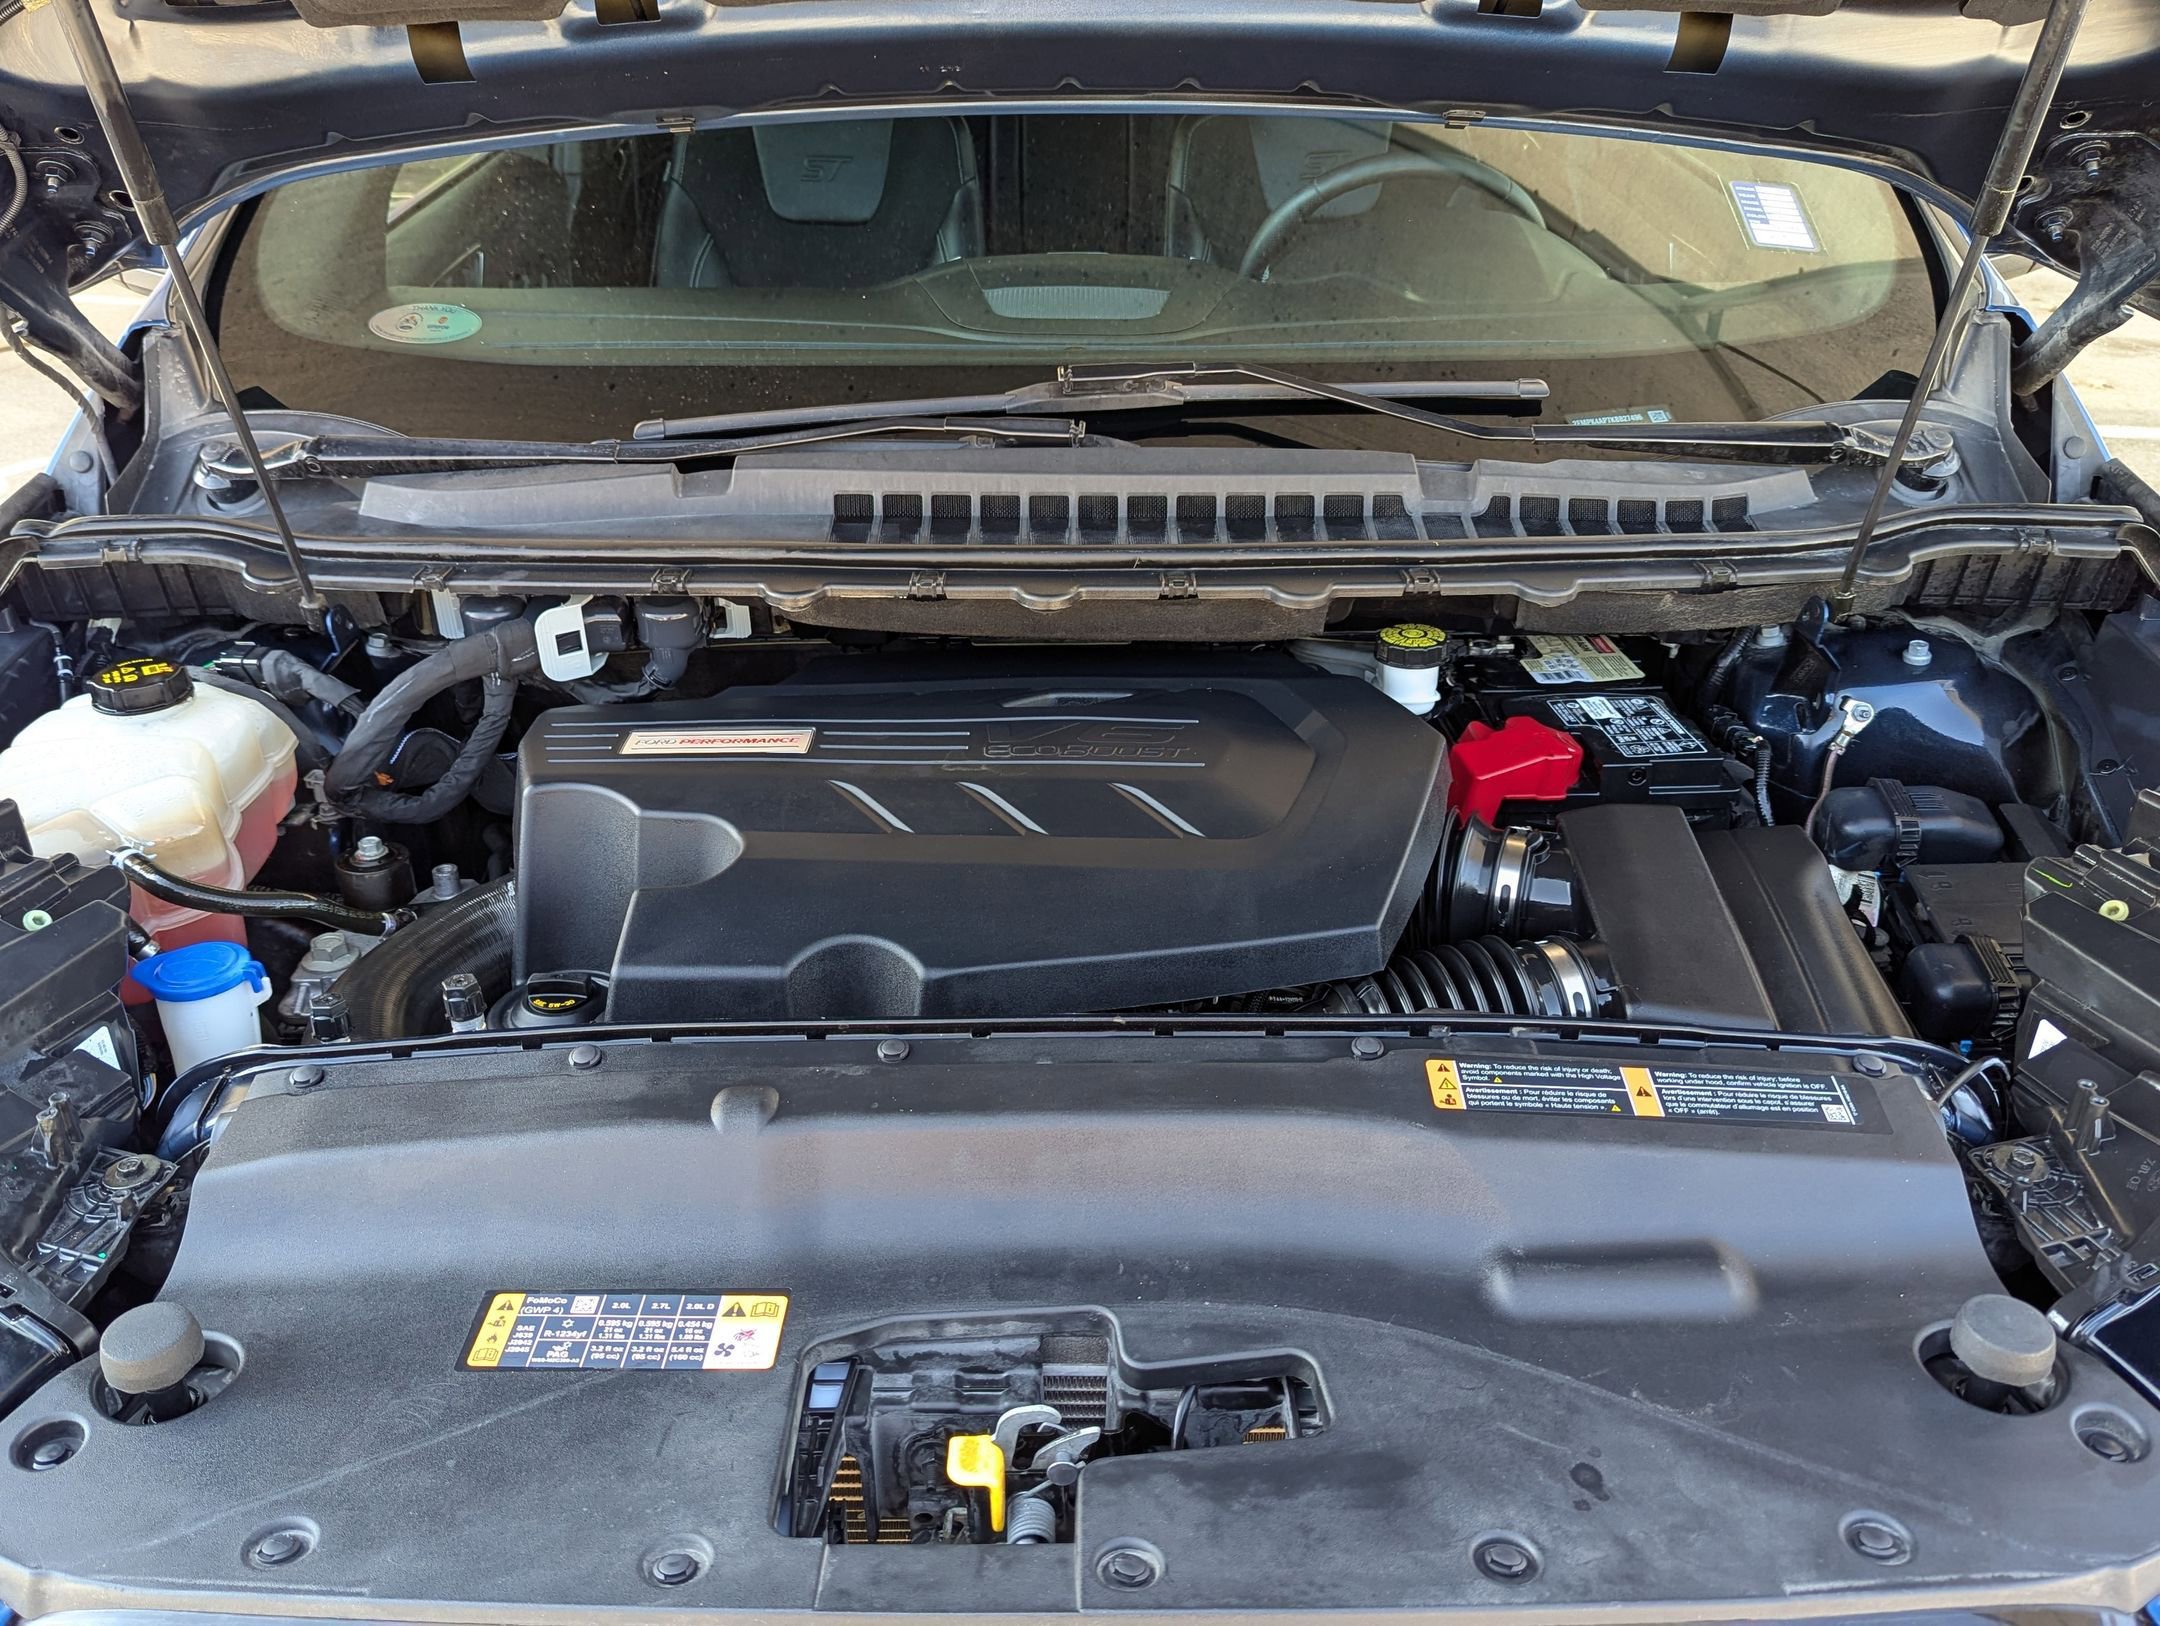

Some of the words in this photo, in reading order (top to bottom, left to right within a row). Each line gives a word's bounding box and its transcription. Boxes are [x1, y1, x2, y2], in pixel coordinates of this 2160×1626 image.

[800, 155, 853, 182] ST
[986, 722, 1185, 743] V6
[635, 738, 677, 746] FORD
[679, 737, 800, 745] PERFORMANCE
[548, 999, 575, 1008] 5W-30
[1459, 1062, 1492, 1070] Warning:
[1654, 1071, 1687, 1079] Warning:
[1661, 1088, 1713, 1096] Avertissement
[526, 1296, 567, 1304] FoMoCo
[651, 1302, 671, 1310] 2.7L
[686, 1302, 706, 1310] 2.0L
[707, 1302, 715, 1310] D
[520, 1306, 551, 1315] (GWP
[552, 1306, 564, 1315] 4)
[622, 1320, 633, 1329] kg
[662, 1320, 674, 1329] kg
[702, 1320, 713, 1329] kg
[544, 1330, 588, 1339] R-1234yf
[606, 1353, 620, 1361] cc)
[647, 1353, 661, 1361] cc)
[689, 1353, 704, 1361] cc)
